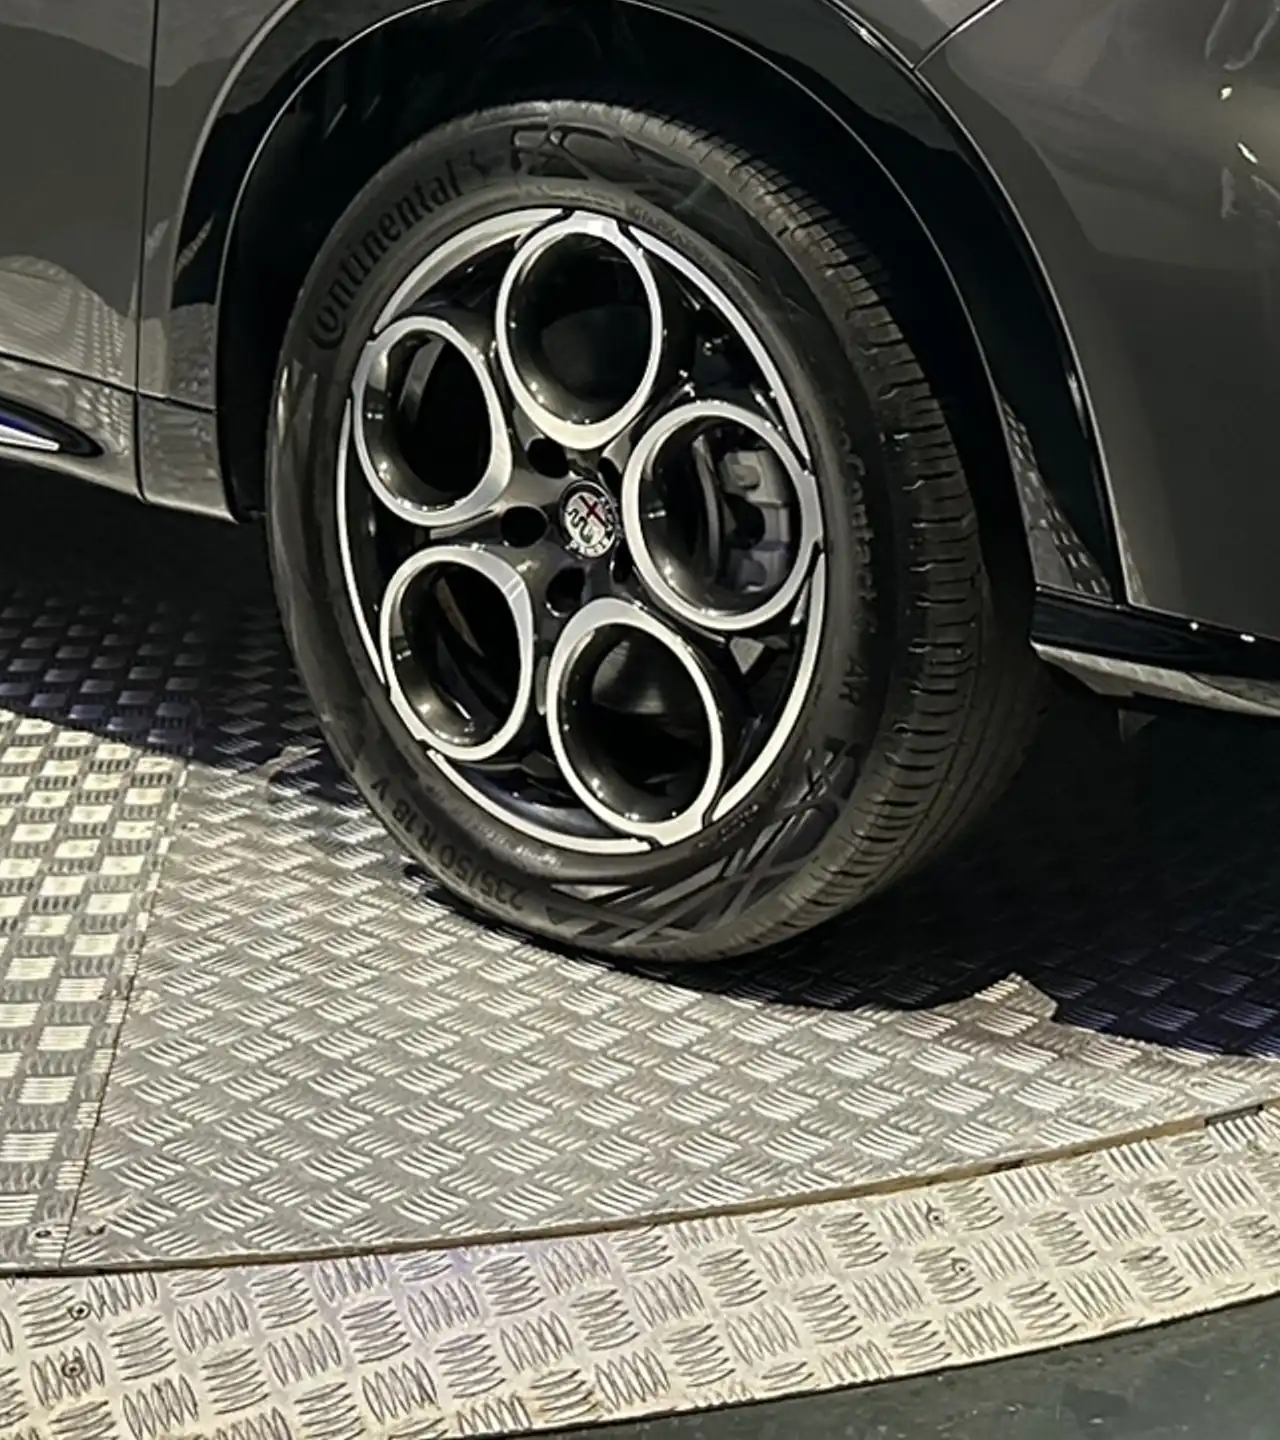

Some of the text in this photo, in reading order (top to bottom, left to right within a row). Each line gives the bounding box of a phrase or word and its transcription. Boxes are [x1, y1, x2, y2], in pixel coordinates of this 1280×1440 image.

[309, 159, 464, 350] Continental
[392, 801, 414, 834] 18
[438, 844, 524, 910] 235/50
